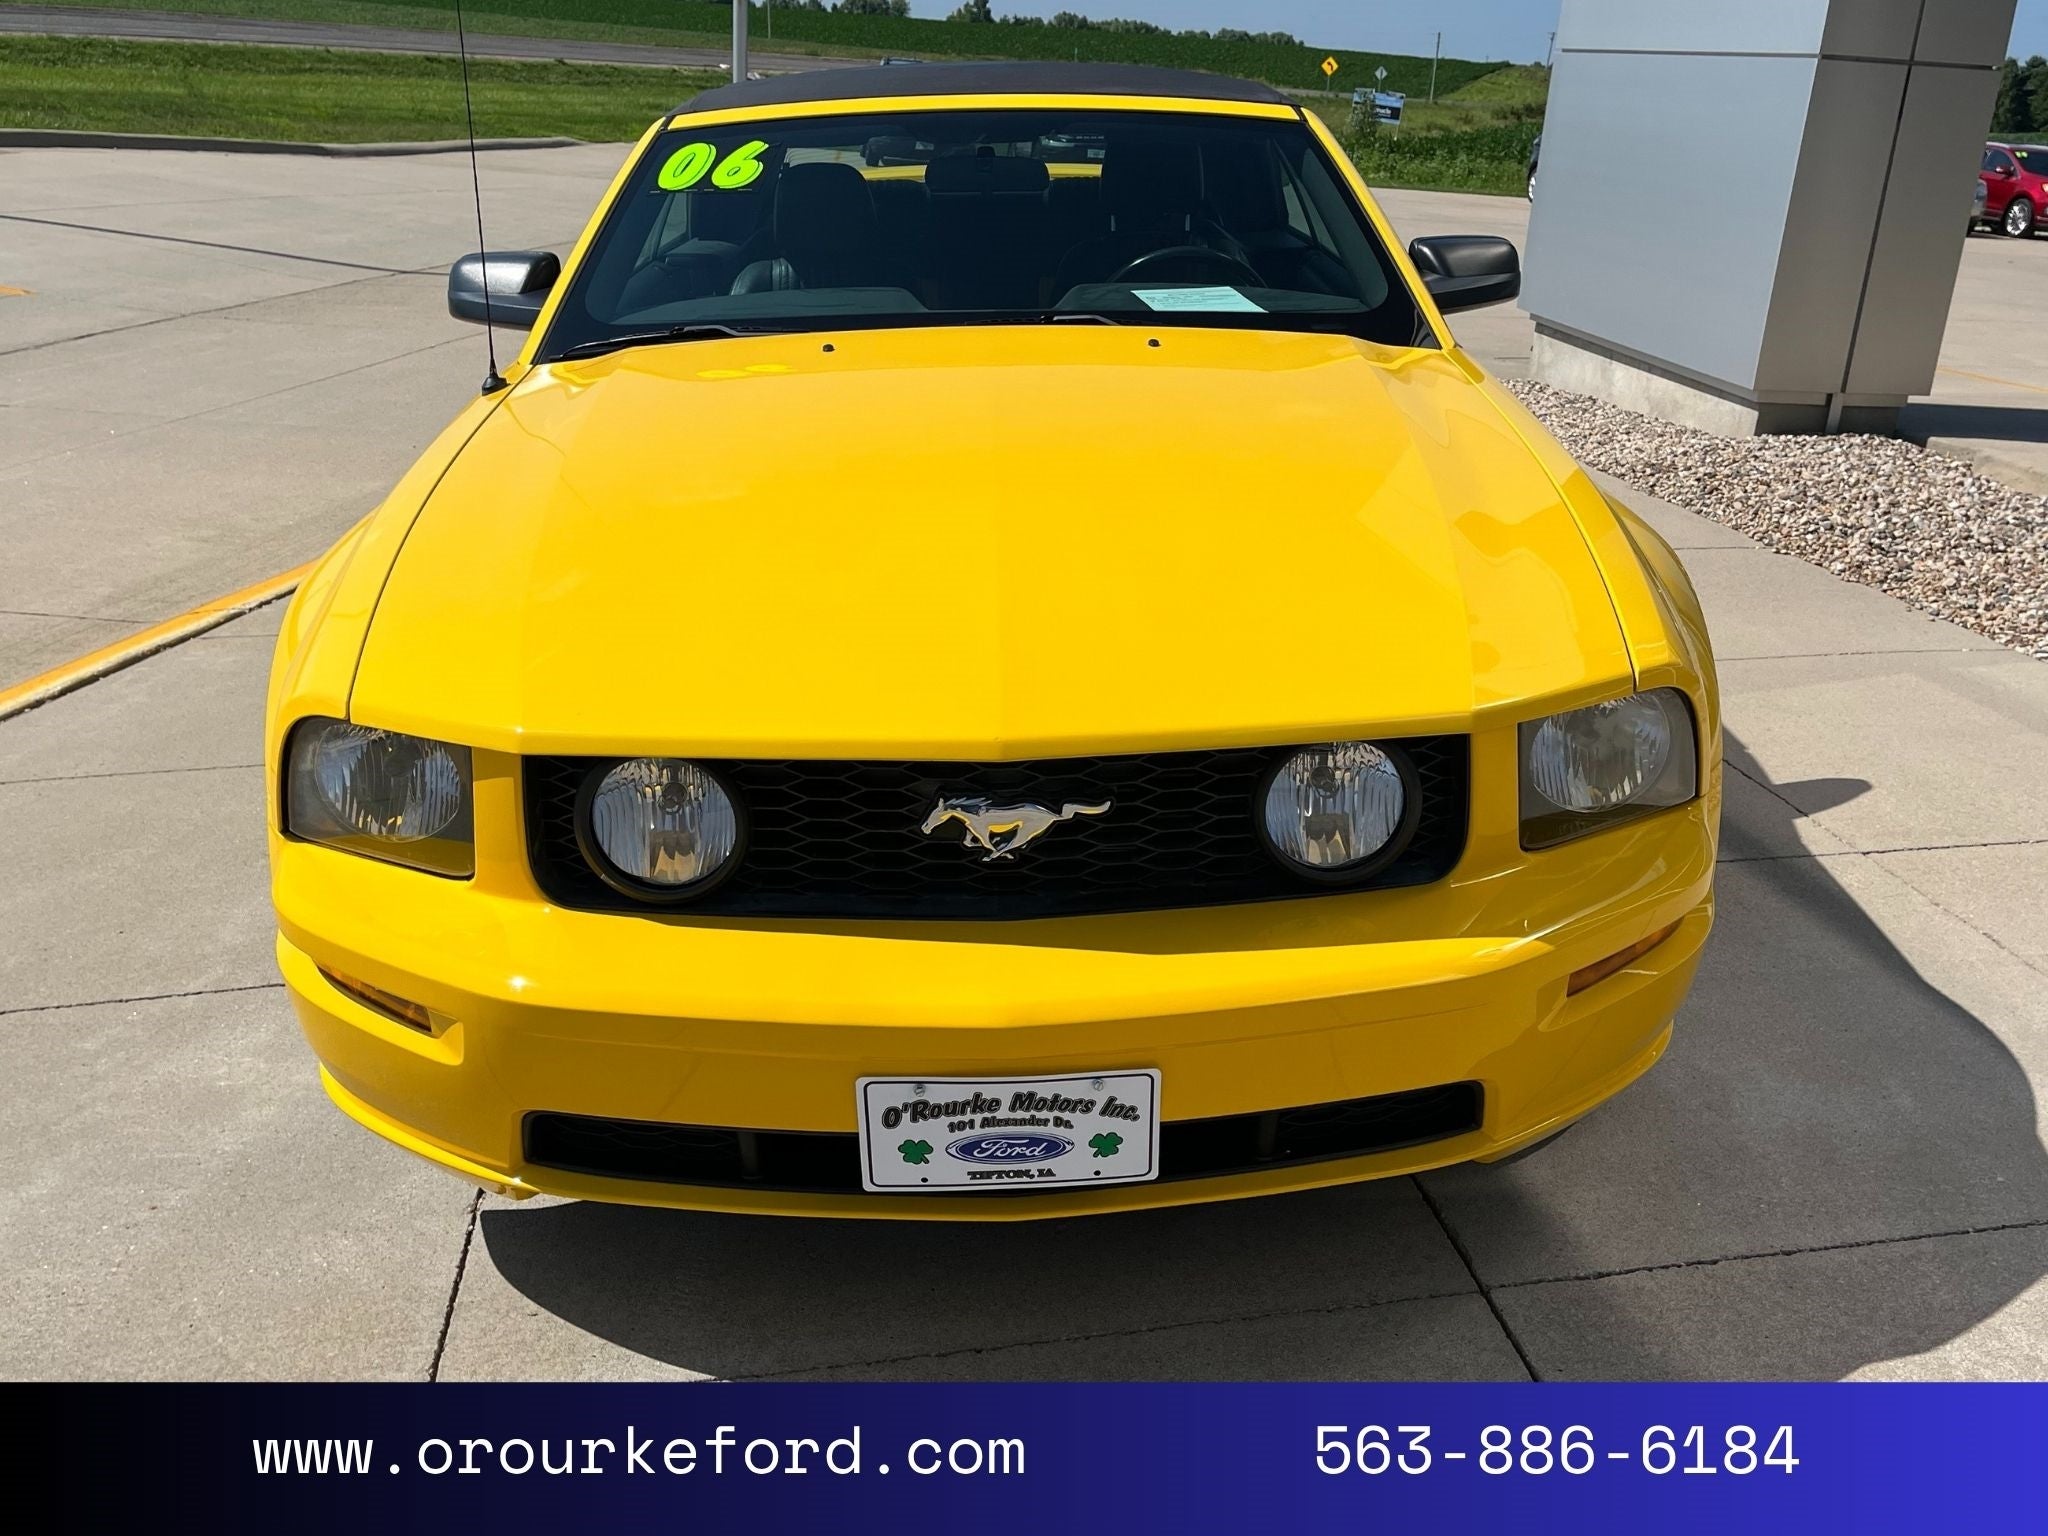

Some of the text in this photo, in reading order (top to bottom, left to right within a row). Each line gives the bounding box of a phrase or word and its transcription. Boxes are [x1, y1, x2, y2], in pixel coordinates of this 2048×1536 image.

[657, 140, 769, 191] 06
[881, 1090, 1140, 1129] O'Rourke Motors Inc.
[947, 1115, 1075, 1133] 101 Alexander Dr.
[973, 1138, 1049, 1158] Ford
[967, 1167, 1057, 1181] TIPTON, IA
